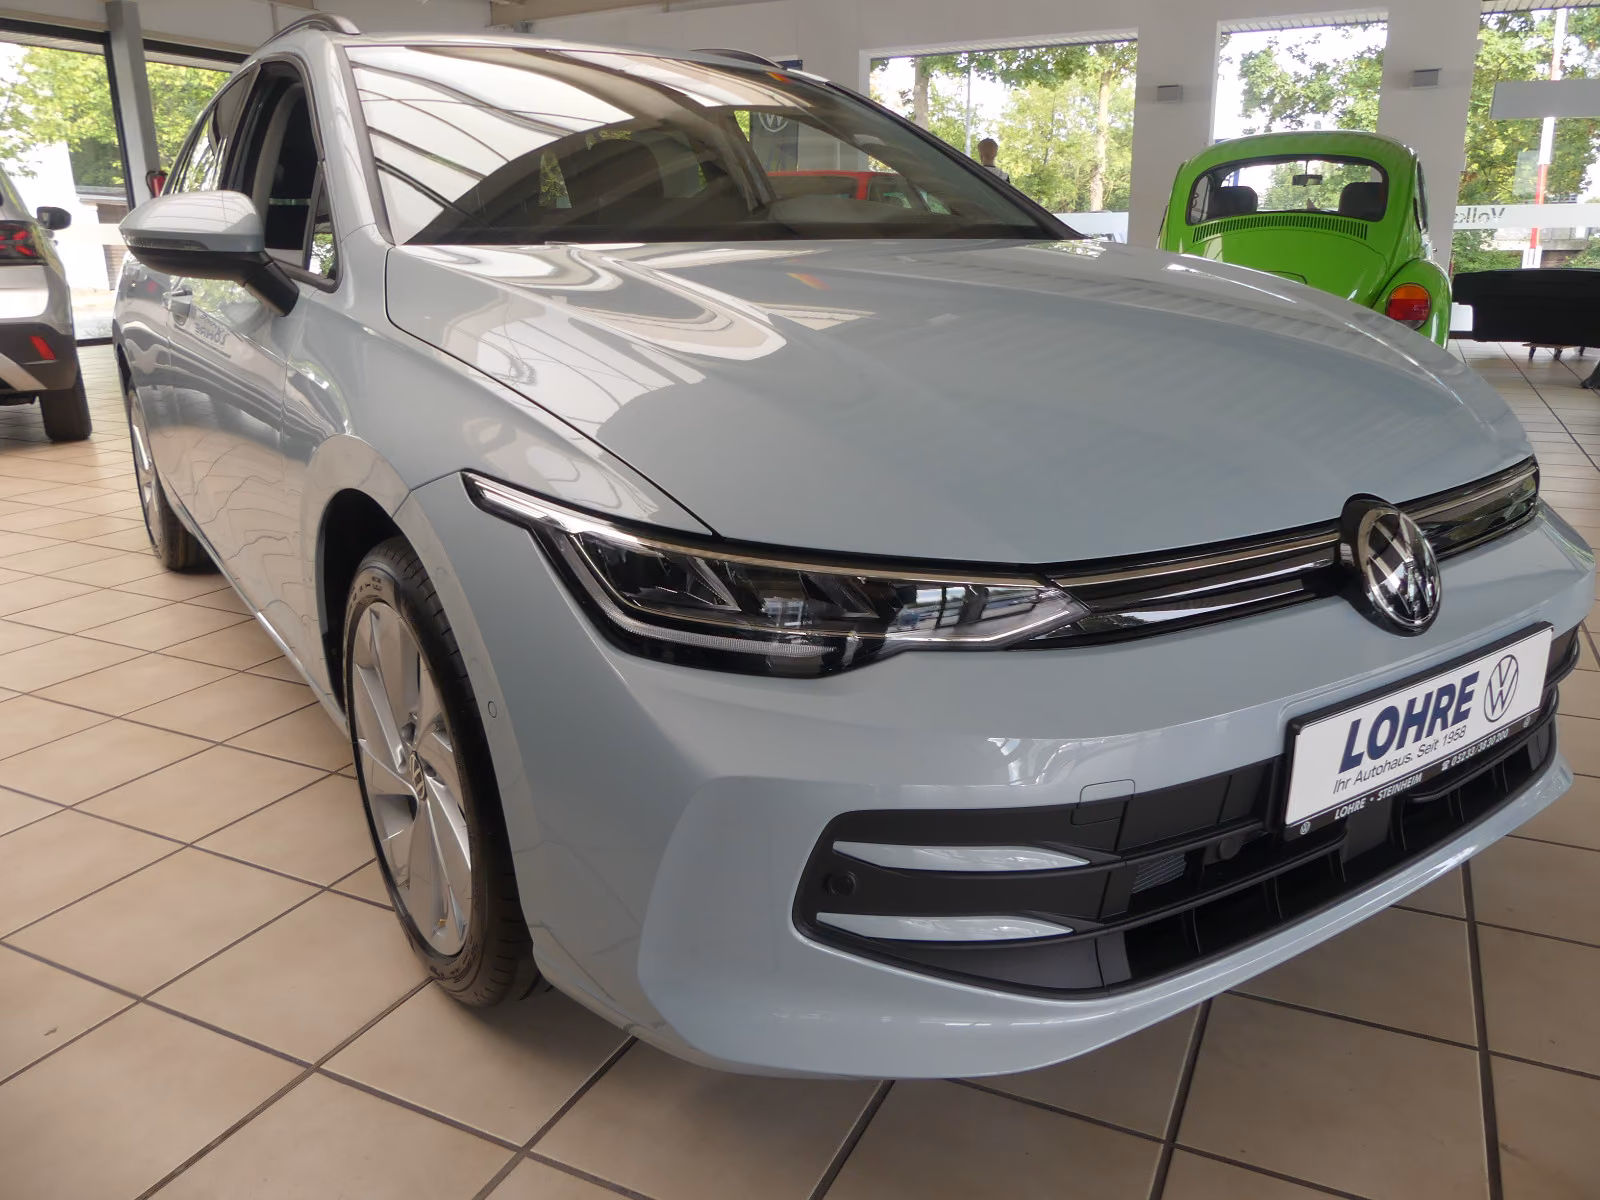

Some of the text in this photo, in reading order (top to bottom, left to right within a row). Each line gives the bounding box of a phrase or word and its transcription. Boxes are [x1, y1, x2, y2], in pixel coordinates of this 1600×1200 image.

[1338, 671, 1480, 774] LOHRE
[1333, 777, 1352, 795] Ihr
[1417, 738, 1439, 758] Seit
[1442, 725, 1467, 746] 1958
[1334, 773, 1423, 820] LOHRE STEINHEIM
